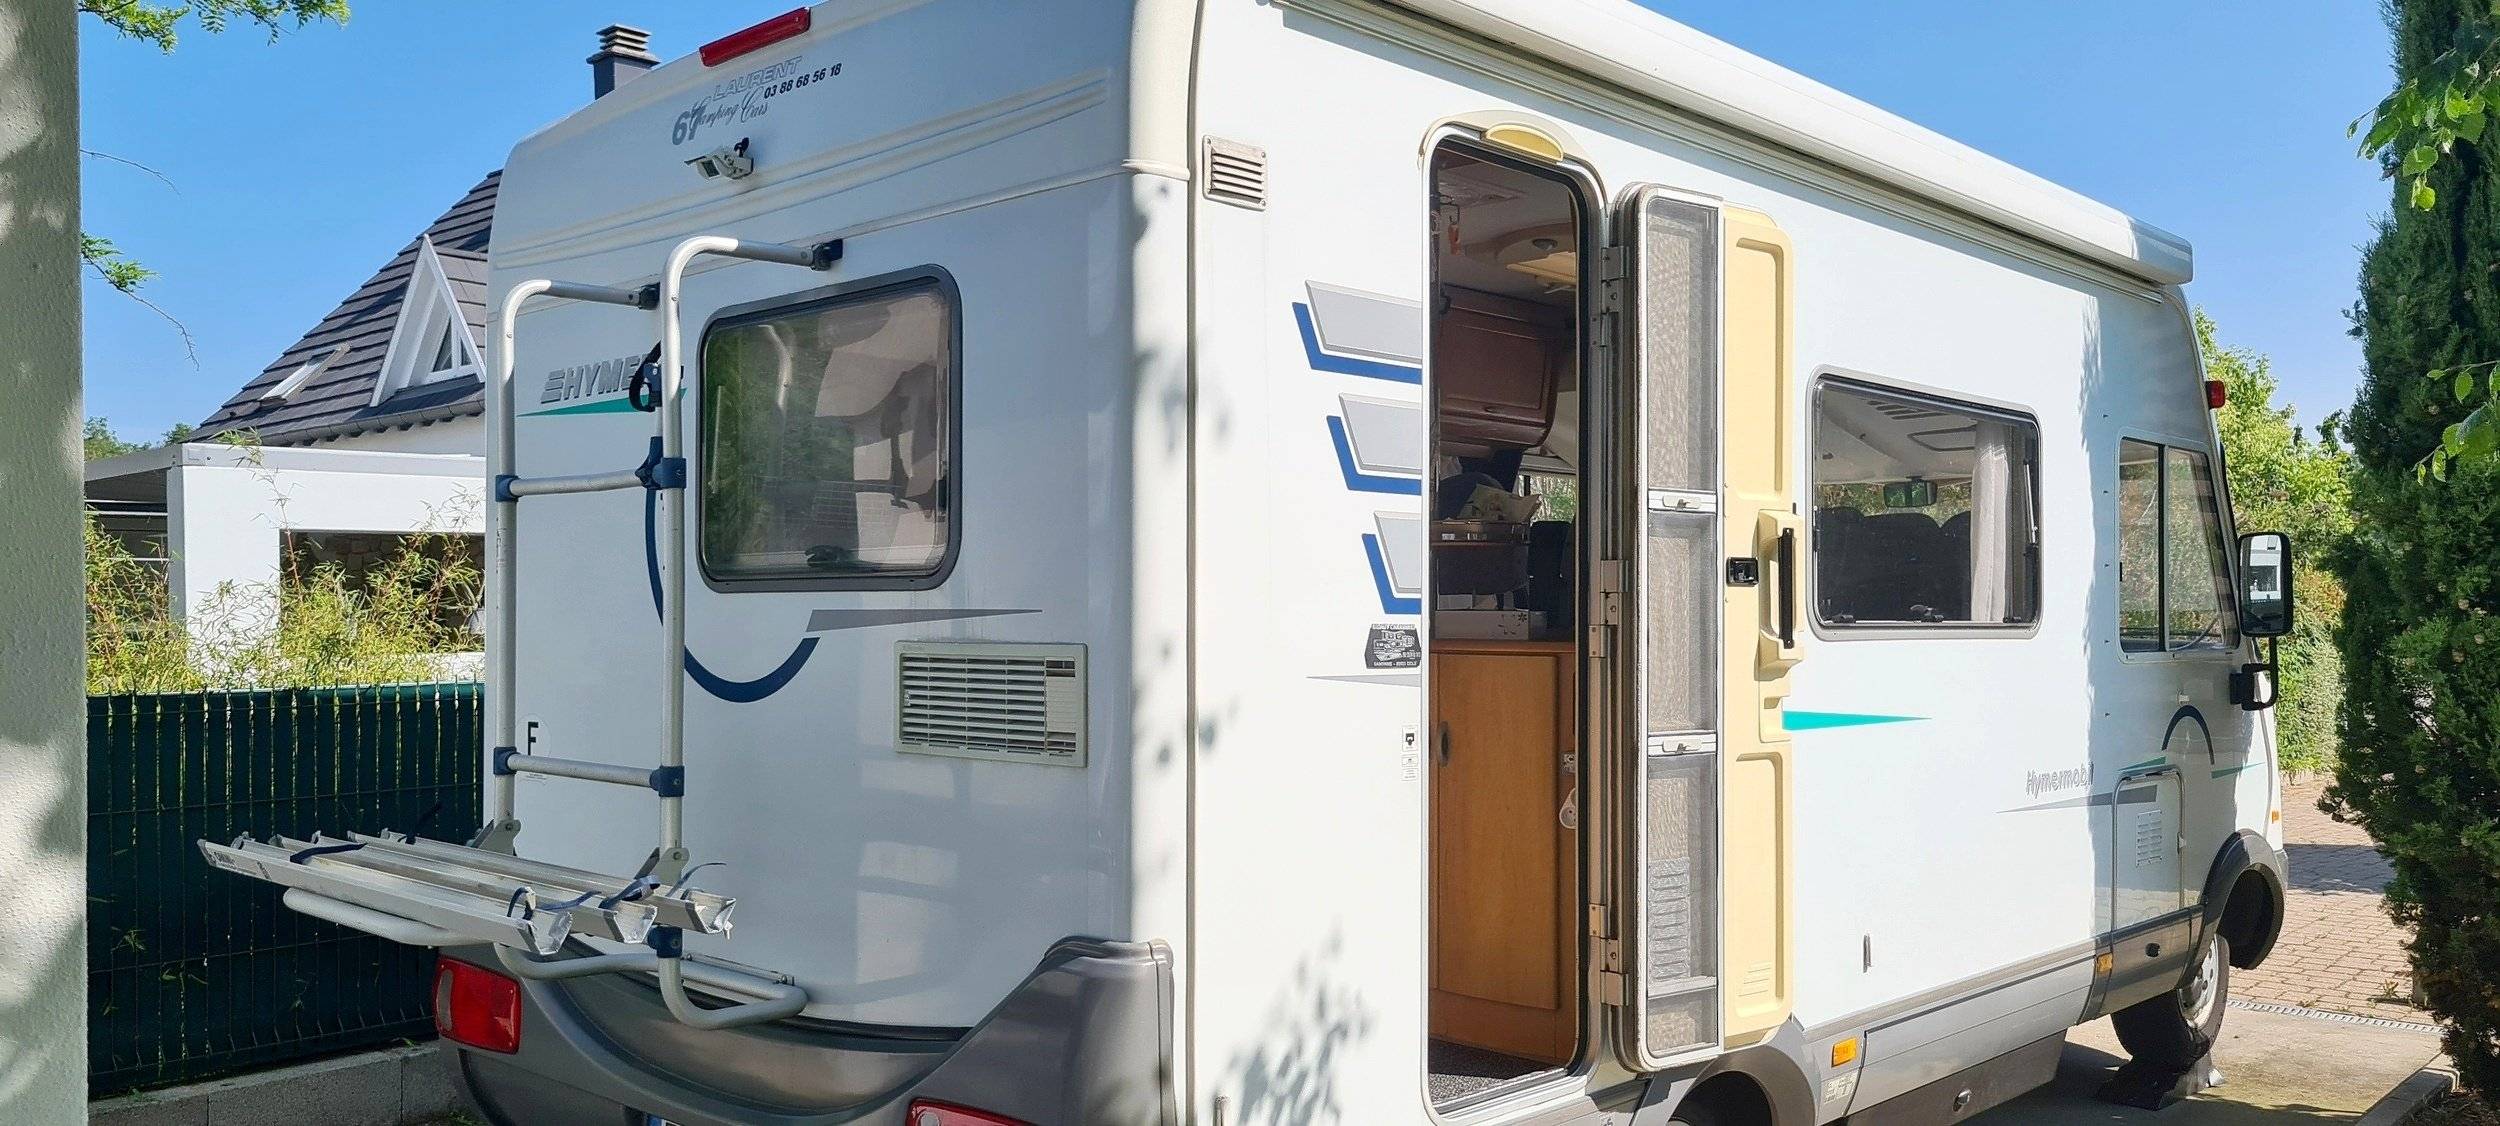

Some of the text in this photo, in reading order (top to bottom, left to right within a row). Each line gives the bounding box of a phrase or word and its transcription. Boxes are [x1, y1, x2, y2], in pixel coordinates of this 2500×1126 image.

[713, 56, 803, 102] LAURENT
[763, 63, 843, 99] 03 88 68 56 18
[527, 721, 539, 756] F
[2026, 760, 2094, 799] Hymermobil
